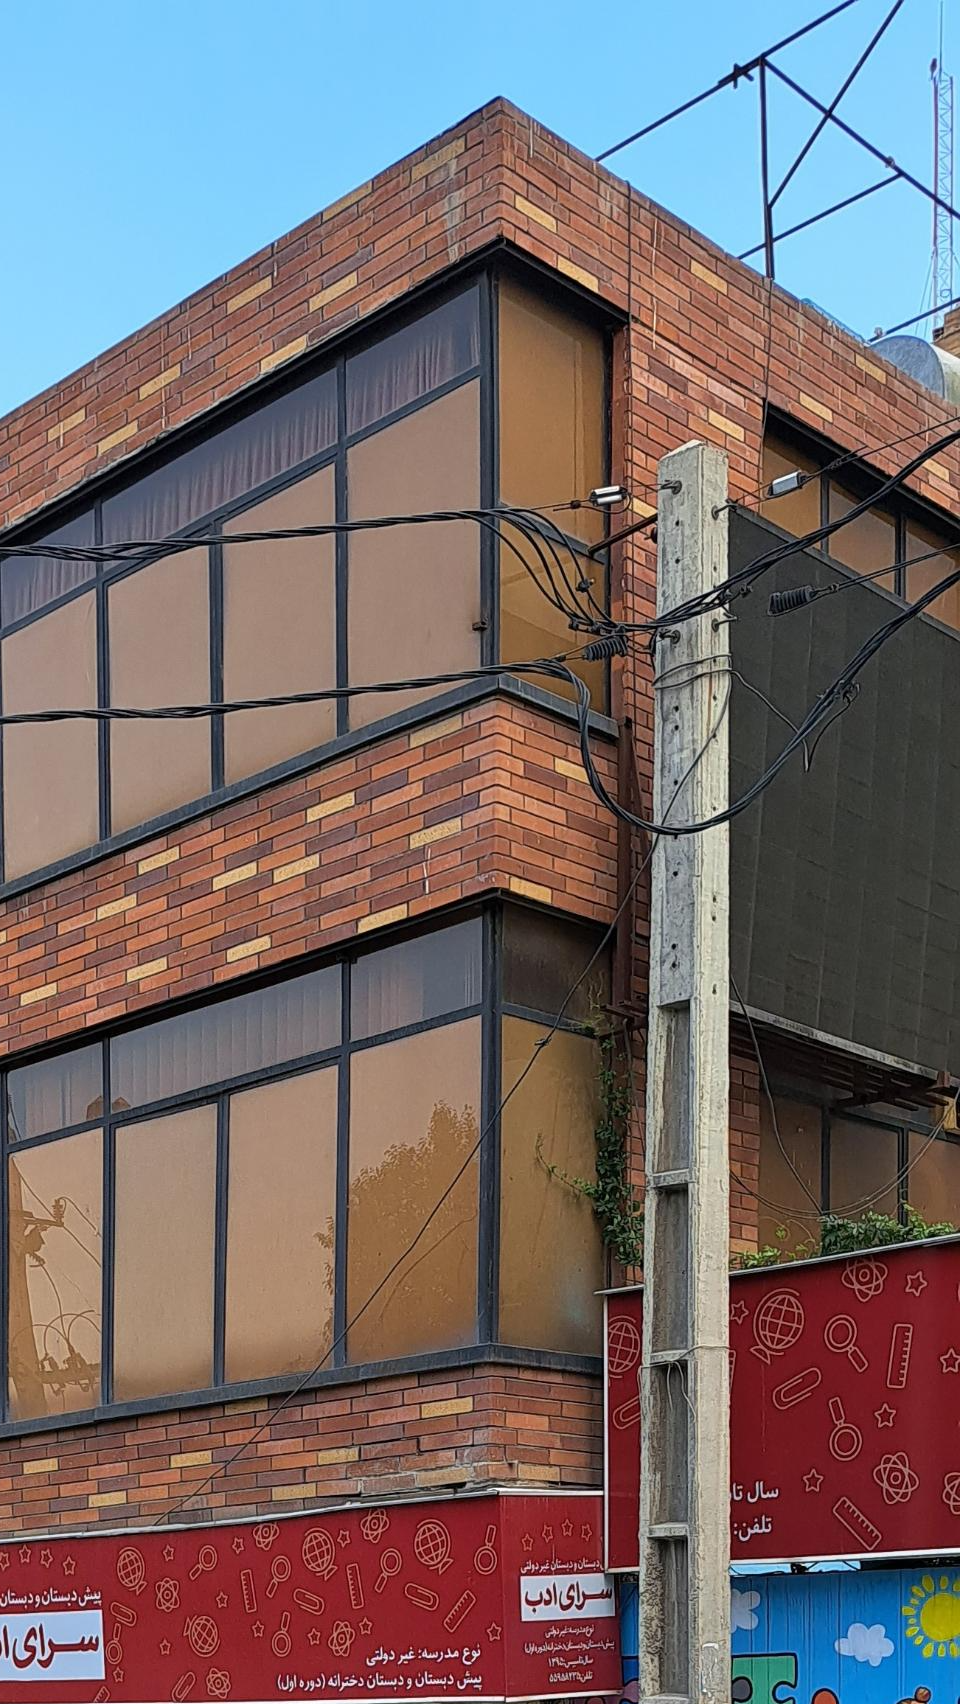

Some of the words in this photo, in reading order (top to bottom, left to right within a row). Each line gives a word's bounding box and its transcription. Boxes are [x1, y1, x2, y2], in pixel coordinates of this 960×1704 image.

[747, 1480, 779, 1503] سال
[733, 1514, 772, 1542] تلفن:
[520, 1560, 539, 1574] دولتی
[539, 1560, 550, 1573] غیر
[551, 1559, 573, 1572] دبستان
[579, 1558, 600, 1571] دبستان
[0, 1589, 34, 1609] دبستان
[34, 1595, 40, 1607] و
[41, 1587, 77, 1607] دبستان
[78, 1586, 102, 1606] پیش
[524, 1581, 558, 1614] ادب
[559, 1581, 613, 1611] سرای
[12, 1623, 100, 1669] سرای
[397, 1646, 415, 1665] غیر
[418, 1646, 459, 1663] مدرسه:
[461, 1643, 481, 1665] نوع
[366, 1646, 395, 1667] دولتی
[299, 1673, 326, 1692] (دوره
[327, 1673, 365, 1692] دخترانه
[366, 1672, 405, 1691] دبستان
[406, 1678, 413, 1690] و
[415, 1670, 455, 1690] دبستان
[456, 1670, 482, 1691] پیش
